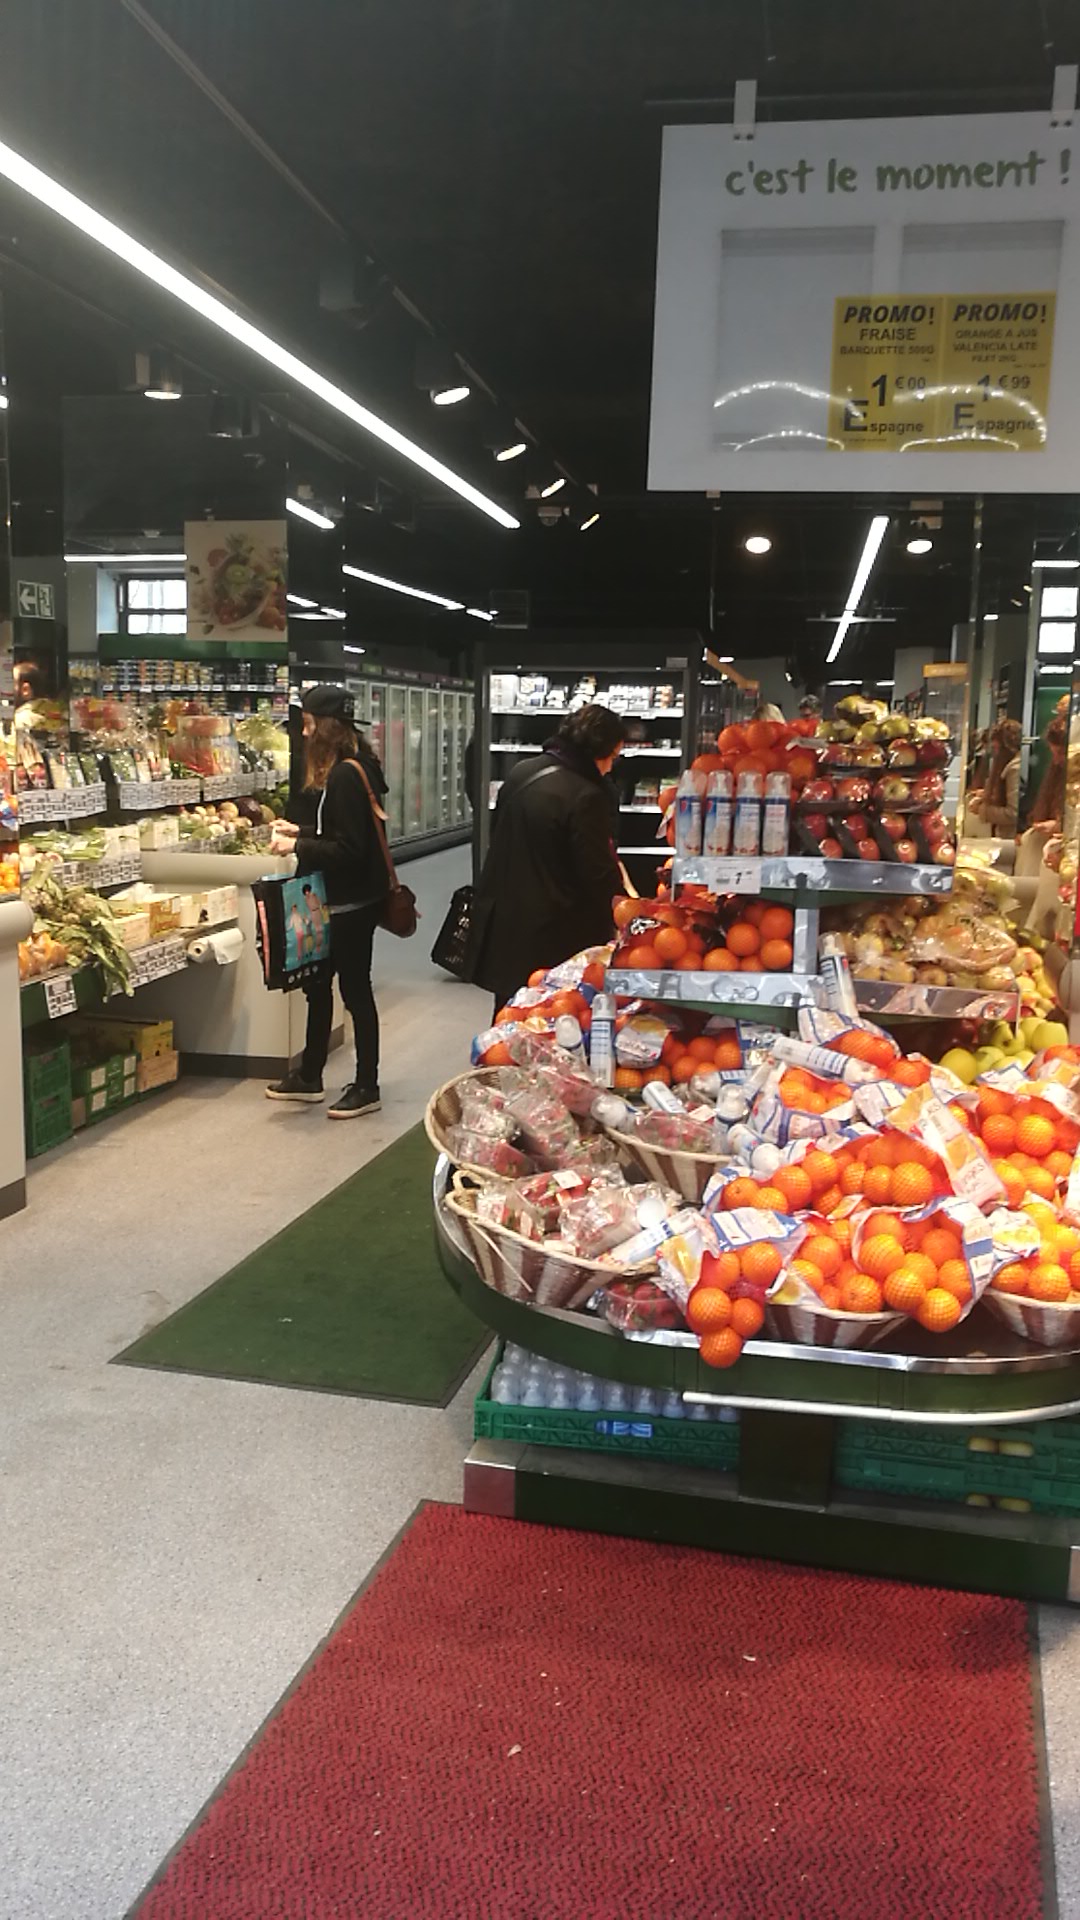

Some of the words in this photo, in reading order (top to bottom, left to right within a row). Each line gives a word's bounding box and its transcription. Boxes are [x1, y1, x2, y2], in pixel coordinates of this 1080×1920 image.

[724, 159, 814, 196] c'est
[827, 157, 857, 193] le
[876, 150, 1046, 191] moment
[843, 304, 935, 325] PROMO!
[952, 302, 1047, 324] PROMO!
[859, 328, 917, 341] FRAISE
[840, 345, 905, 355] BARQUETTE
[1010, 341, 1038, 351] LATE
[871, 374, 887, 407] 1
